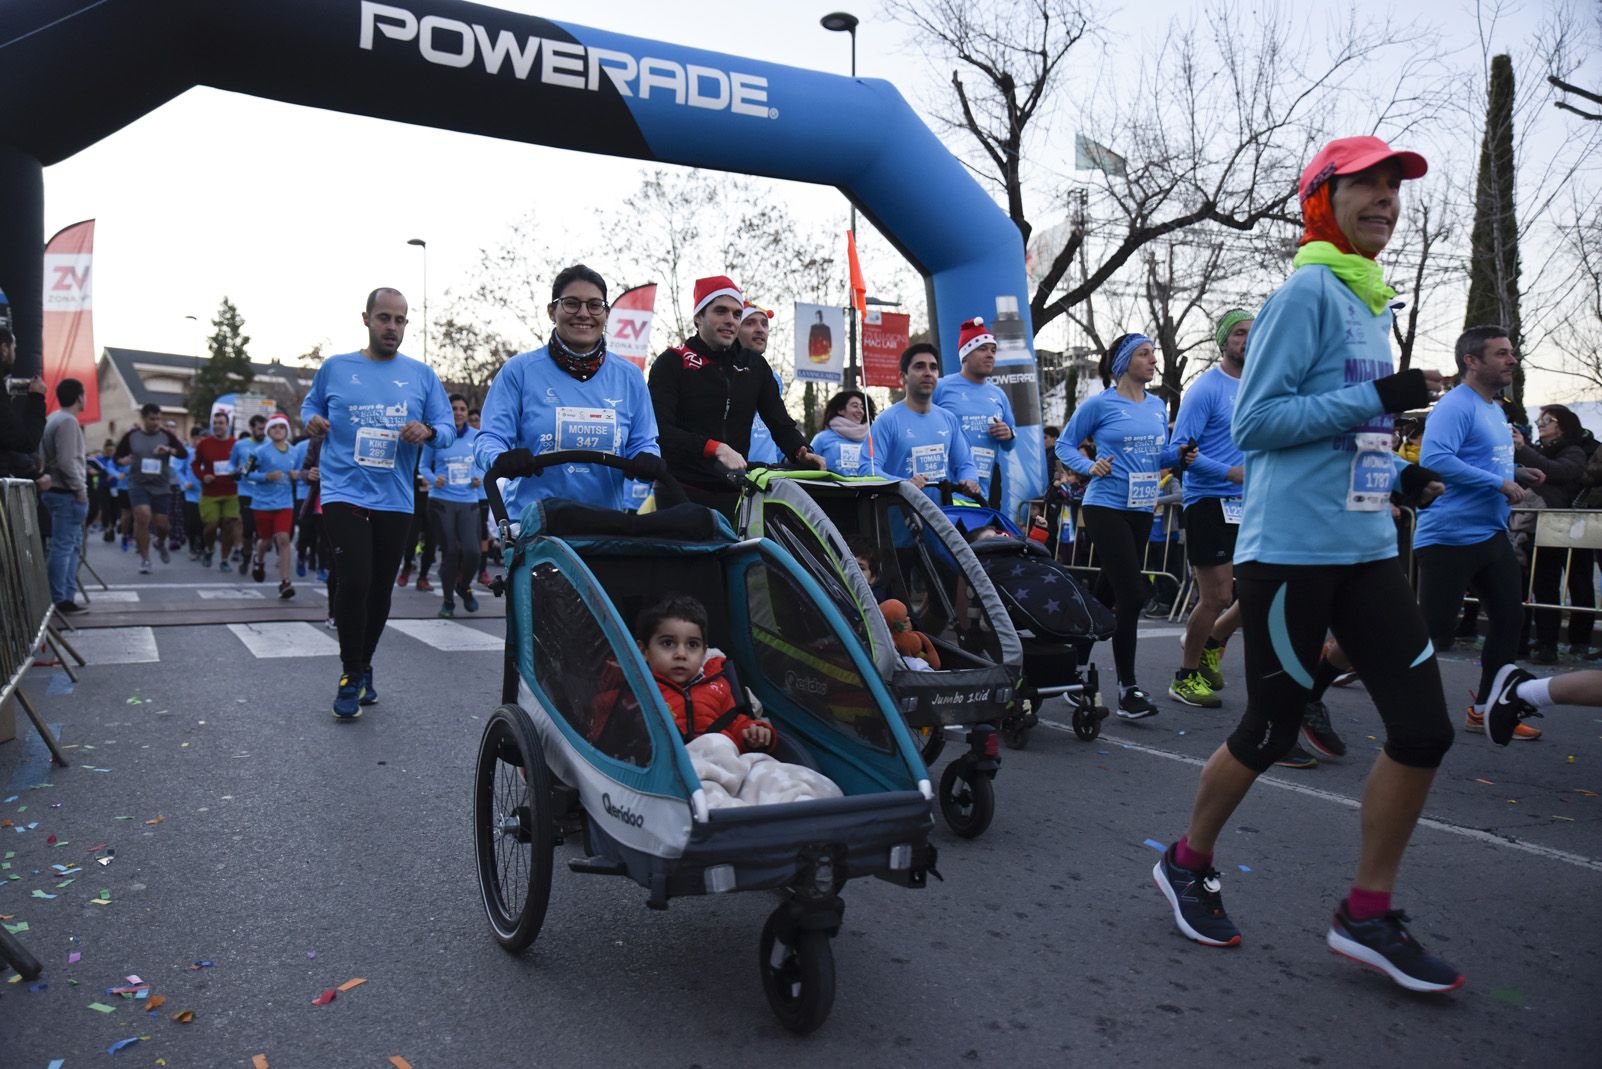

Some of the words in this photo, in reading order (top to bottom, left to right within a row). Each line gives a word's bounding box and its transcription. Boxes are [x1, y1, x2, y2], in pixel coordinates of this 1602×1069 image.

[359, 0, 769, 118] POWERADE
[614, 319, 649, 341] ZV
[568, 424, 608, 435] MONTSE
[540, 433, 553, 442] 20
[576, 436, 600, 448] 347
[368, 440, 388, 448] KIKE
[1133, 486, 1156, 498] 2196
[931, 691, 964, 705] Jumbo
[602, 792, 644, 828] Qeridoo
